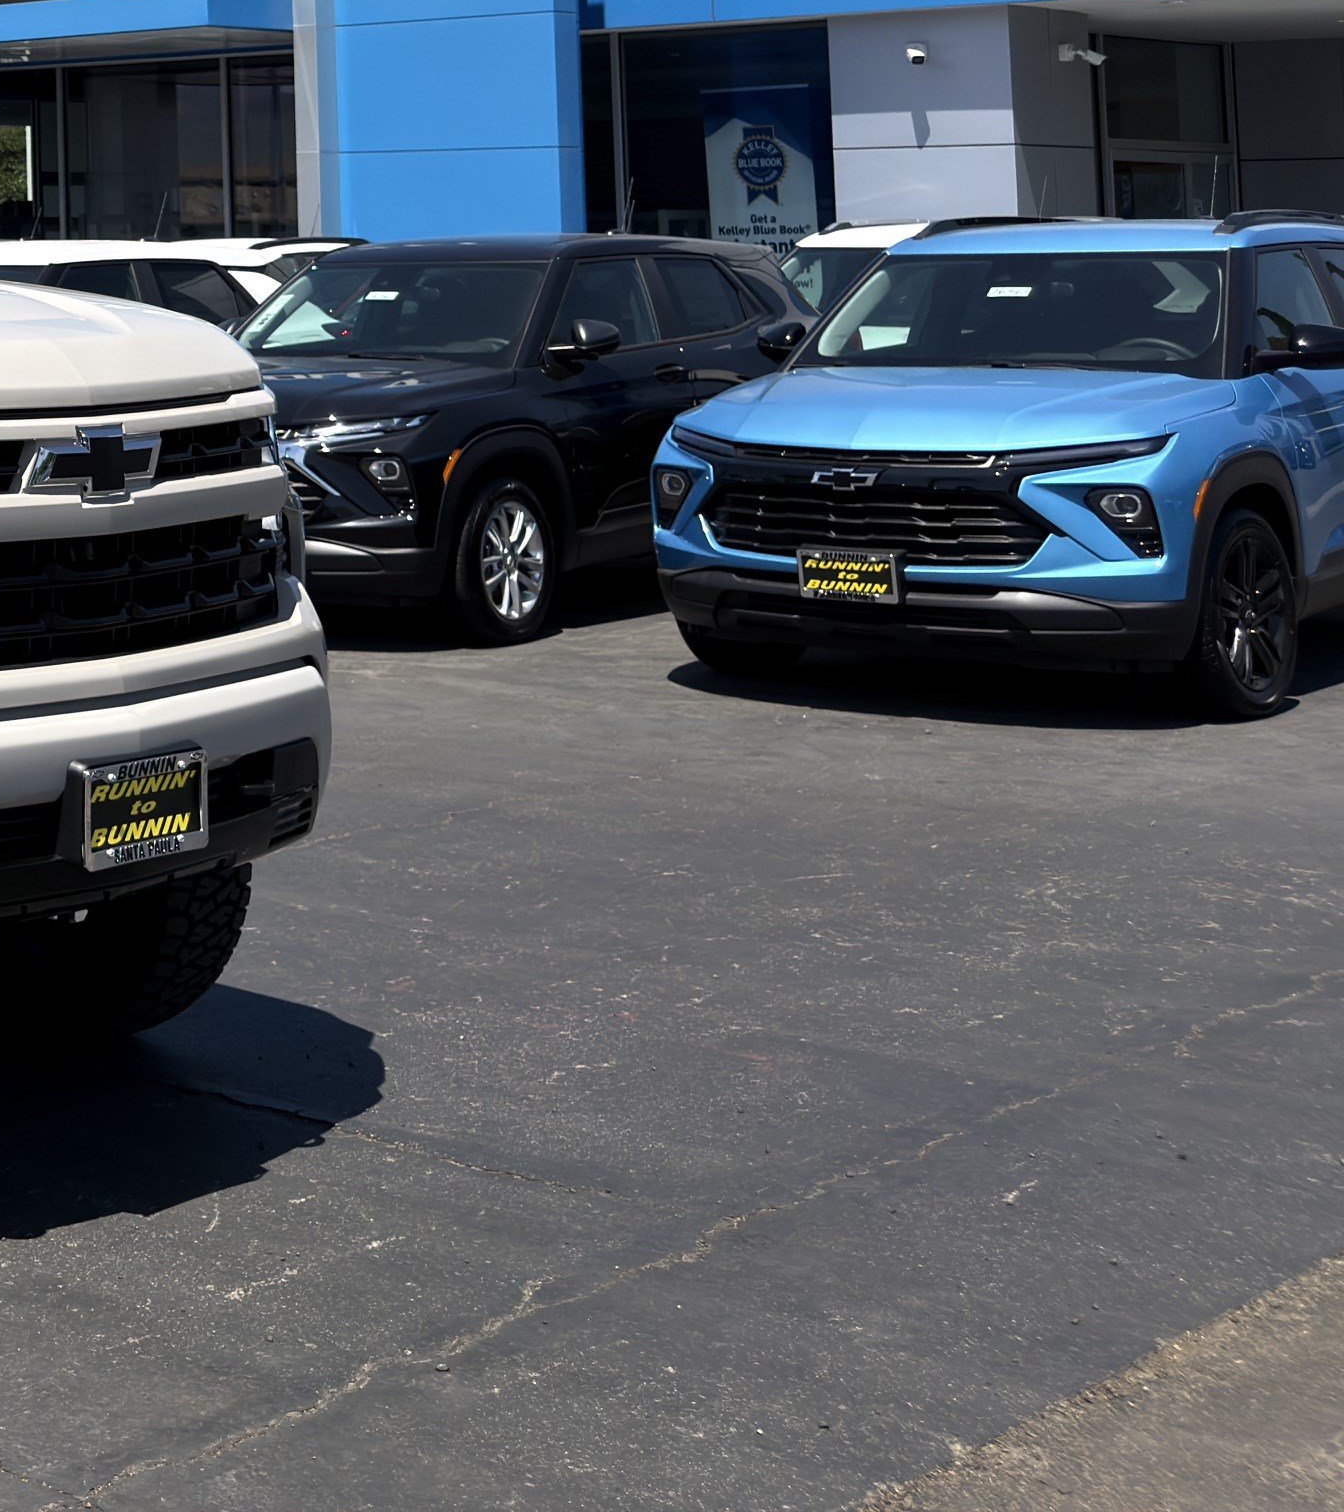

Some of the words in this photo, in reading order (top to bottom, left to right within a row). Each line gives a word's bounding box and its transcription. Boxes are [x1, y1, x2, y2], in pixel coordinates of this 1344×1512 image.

[741, 140, 779, 156] KELLEY
[738, 157, 759, 168] BLUE
[759, 156, 783, 168] BOOK
[750, 214, 768, 224] Get
[770, 215, 777, 224] a
[718, 225, 750, 237] Kelley
[753, 225, 777, 235] Blue
[804, 558, 890, 573] RUNNIN'
[837, 571, 859, 580] to
[806, 578, 888, 594] BUNNIN
[116, 756, 177, 780] BUNNIN
[91, 769, 197, 804] RUNNIN'
[130, 800, 157, 816] to
[91, 811, 192, 849] BUNNIN
[114, 842, 146, 865] SANTA
[146, 836, 181, 857] PAULA
